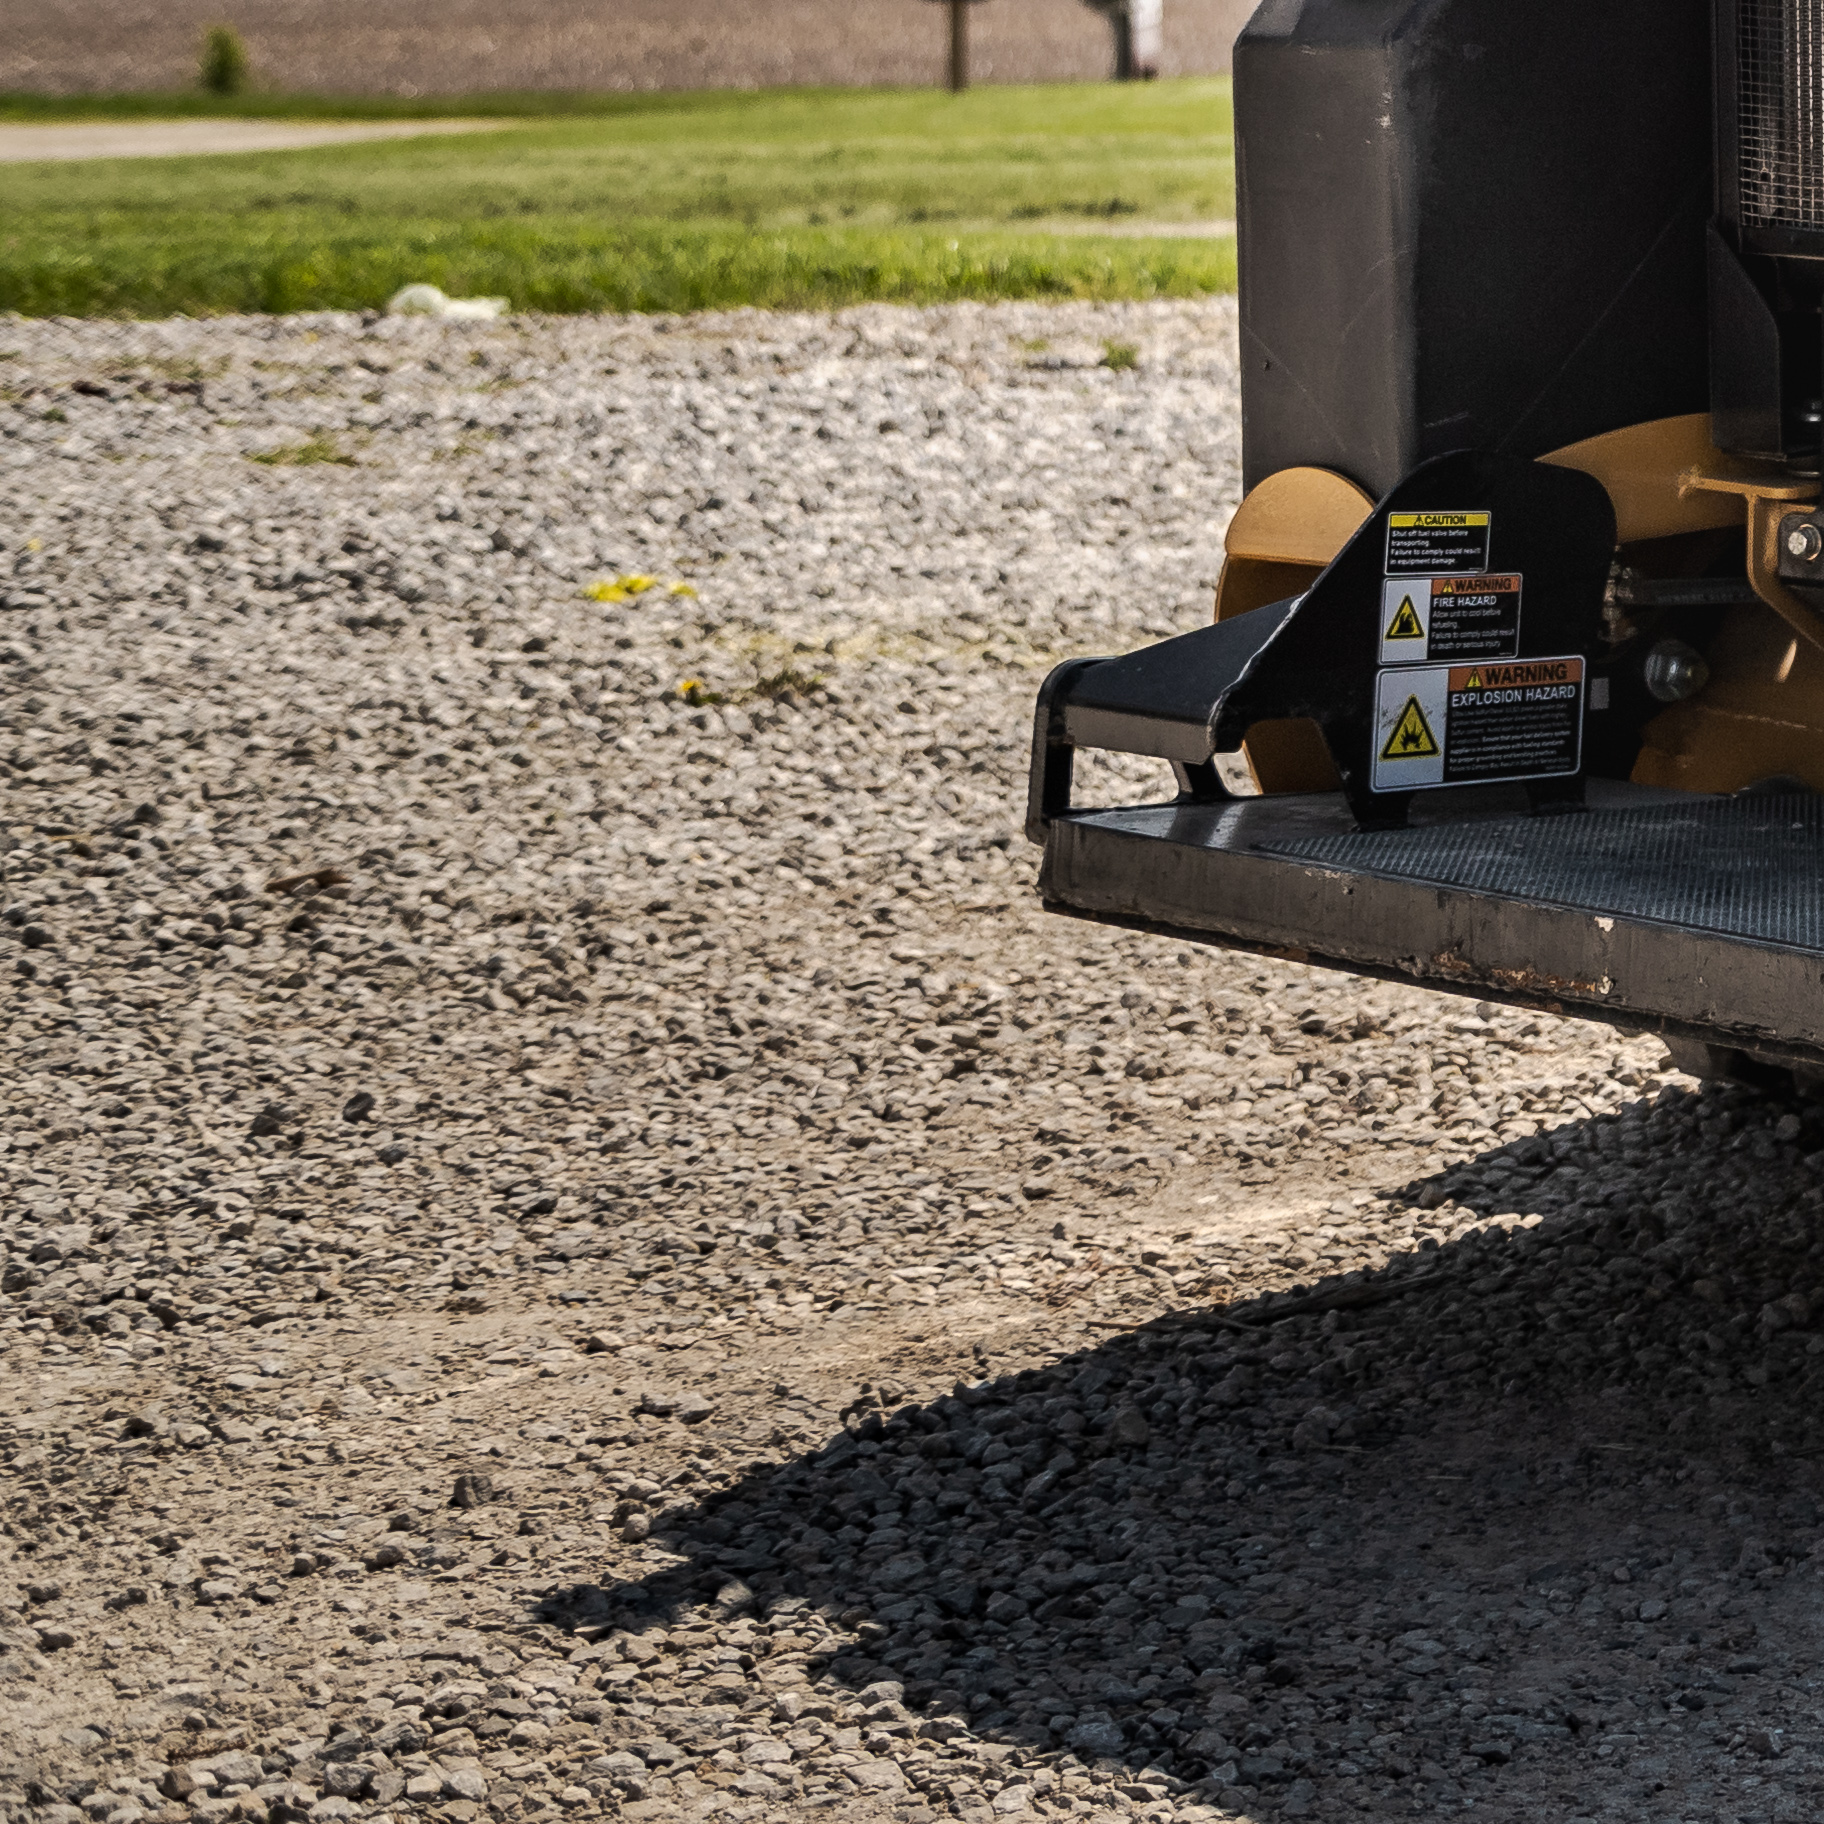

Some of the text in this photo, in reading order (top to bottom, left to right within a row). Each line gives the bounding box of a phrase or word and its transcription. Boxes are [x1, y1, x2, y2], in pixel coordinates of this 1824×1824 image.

[1425, 516, 1467, 525] CAUTION
[1390, 548, 1412, 556] Failure
[1421, 548, 1443, 556] comply
[1398, 558, 1430, 566] equipment
[1455, 578, 1512, 591] WARNING
[1433, 596, 1497, 608] FIRE HAZARD
[1485, 662, 1568, 685] WARNING
[1452, 684, 1576, 708] EXPLOSION HAZARD
